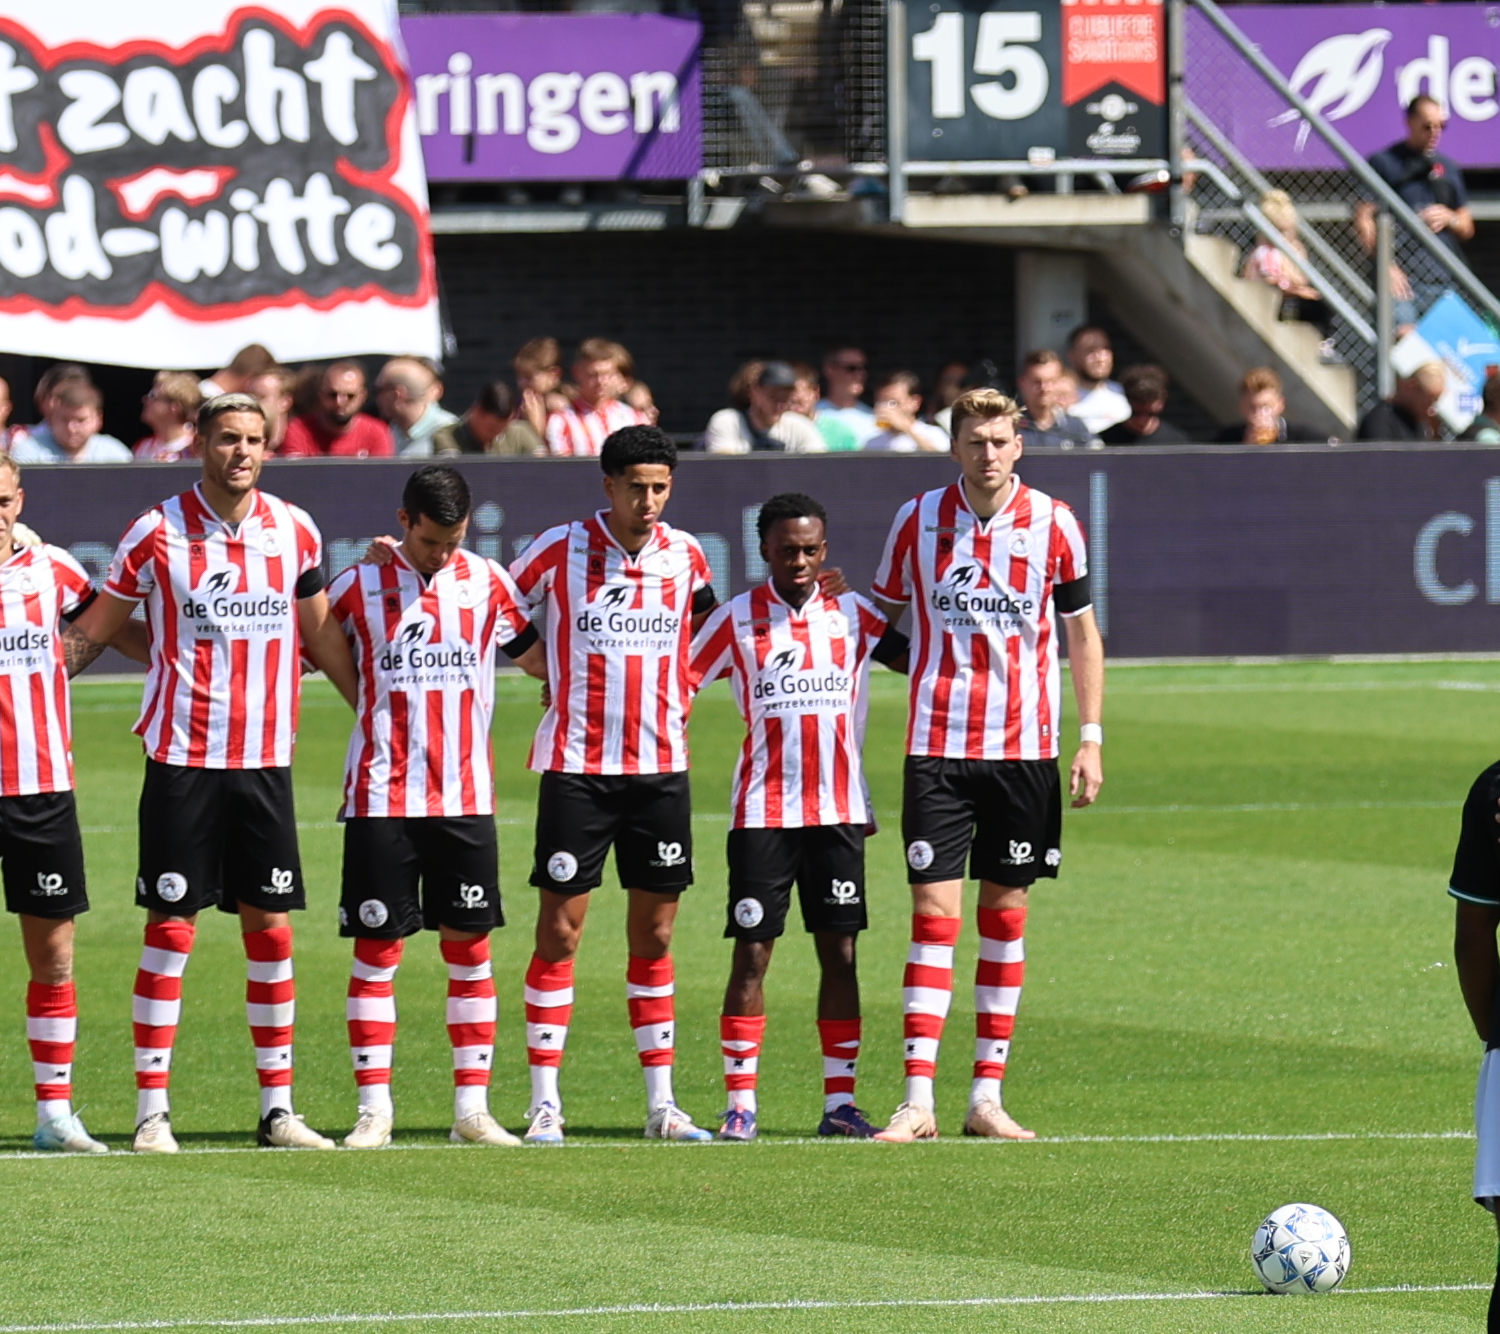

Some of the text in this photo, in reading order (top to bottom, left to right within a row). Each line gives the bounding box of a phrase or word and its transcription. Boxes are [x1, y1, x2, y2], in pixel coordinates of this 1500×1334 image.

[912, 11, 1050, 121] 15
[1398, 35, 1498, 120] de
[57, 28, 376, 157] zacht
[183, 595, 288, 619] de Goudse
[931, 589, 1032, 616] de Goudse
[576, 611, 680, 634] de Goudse
[380, 646, 478, 671] de Goudse
[754, 672, 849, 698] de Goudse
